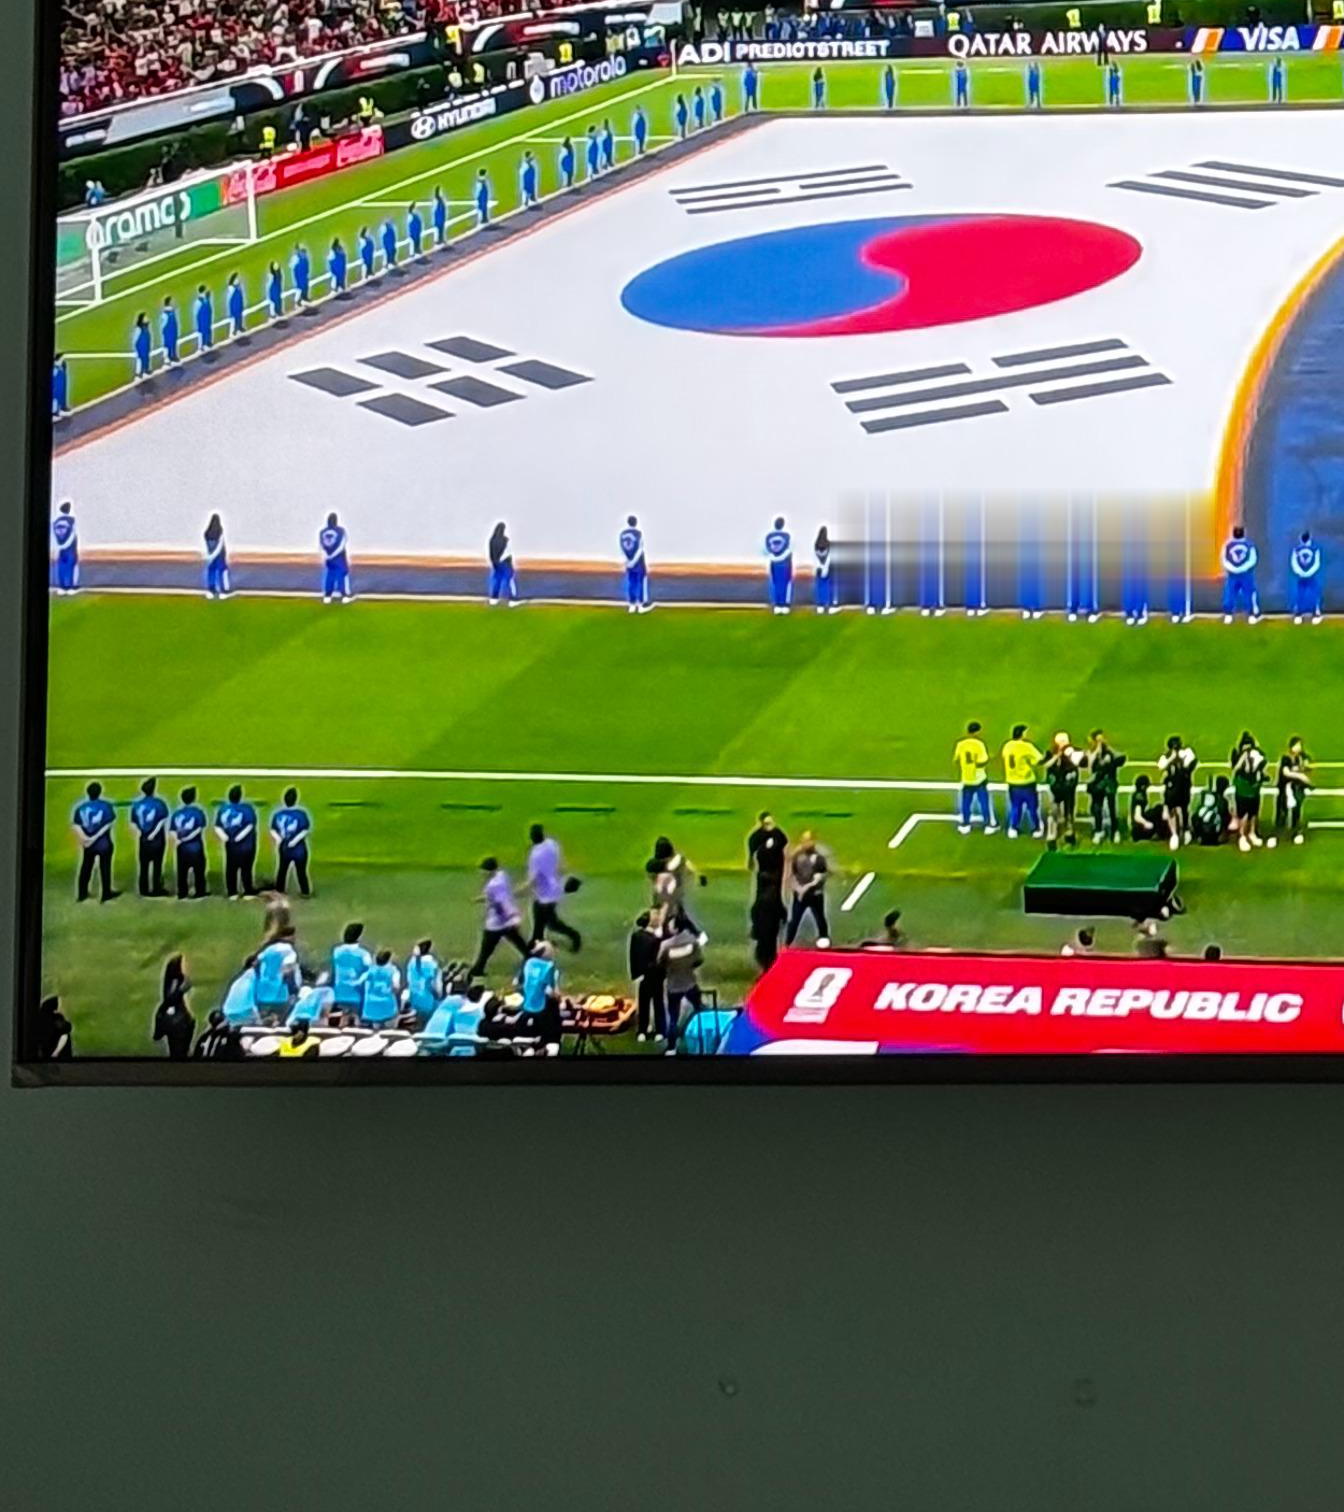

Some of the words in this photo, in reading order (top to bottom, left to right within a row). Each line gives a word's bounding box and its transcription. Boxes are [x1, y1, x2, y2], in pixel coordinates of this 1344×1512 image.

[948, 34, 1033, 58] QATAR
[1040, 30, 1148, 55] AIRWAYS
[1238, 23, 1301, 51] VISA
[550, 54, 627, 98] motorola
[874, 982, 1041, 1015] KOREA
[1050, 986, 1304, 1023] REPUBLIC
